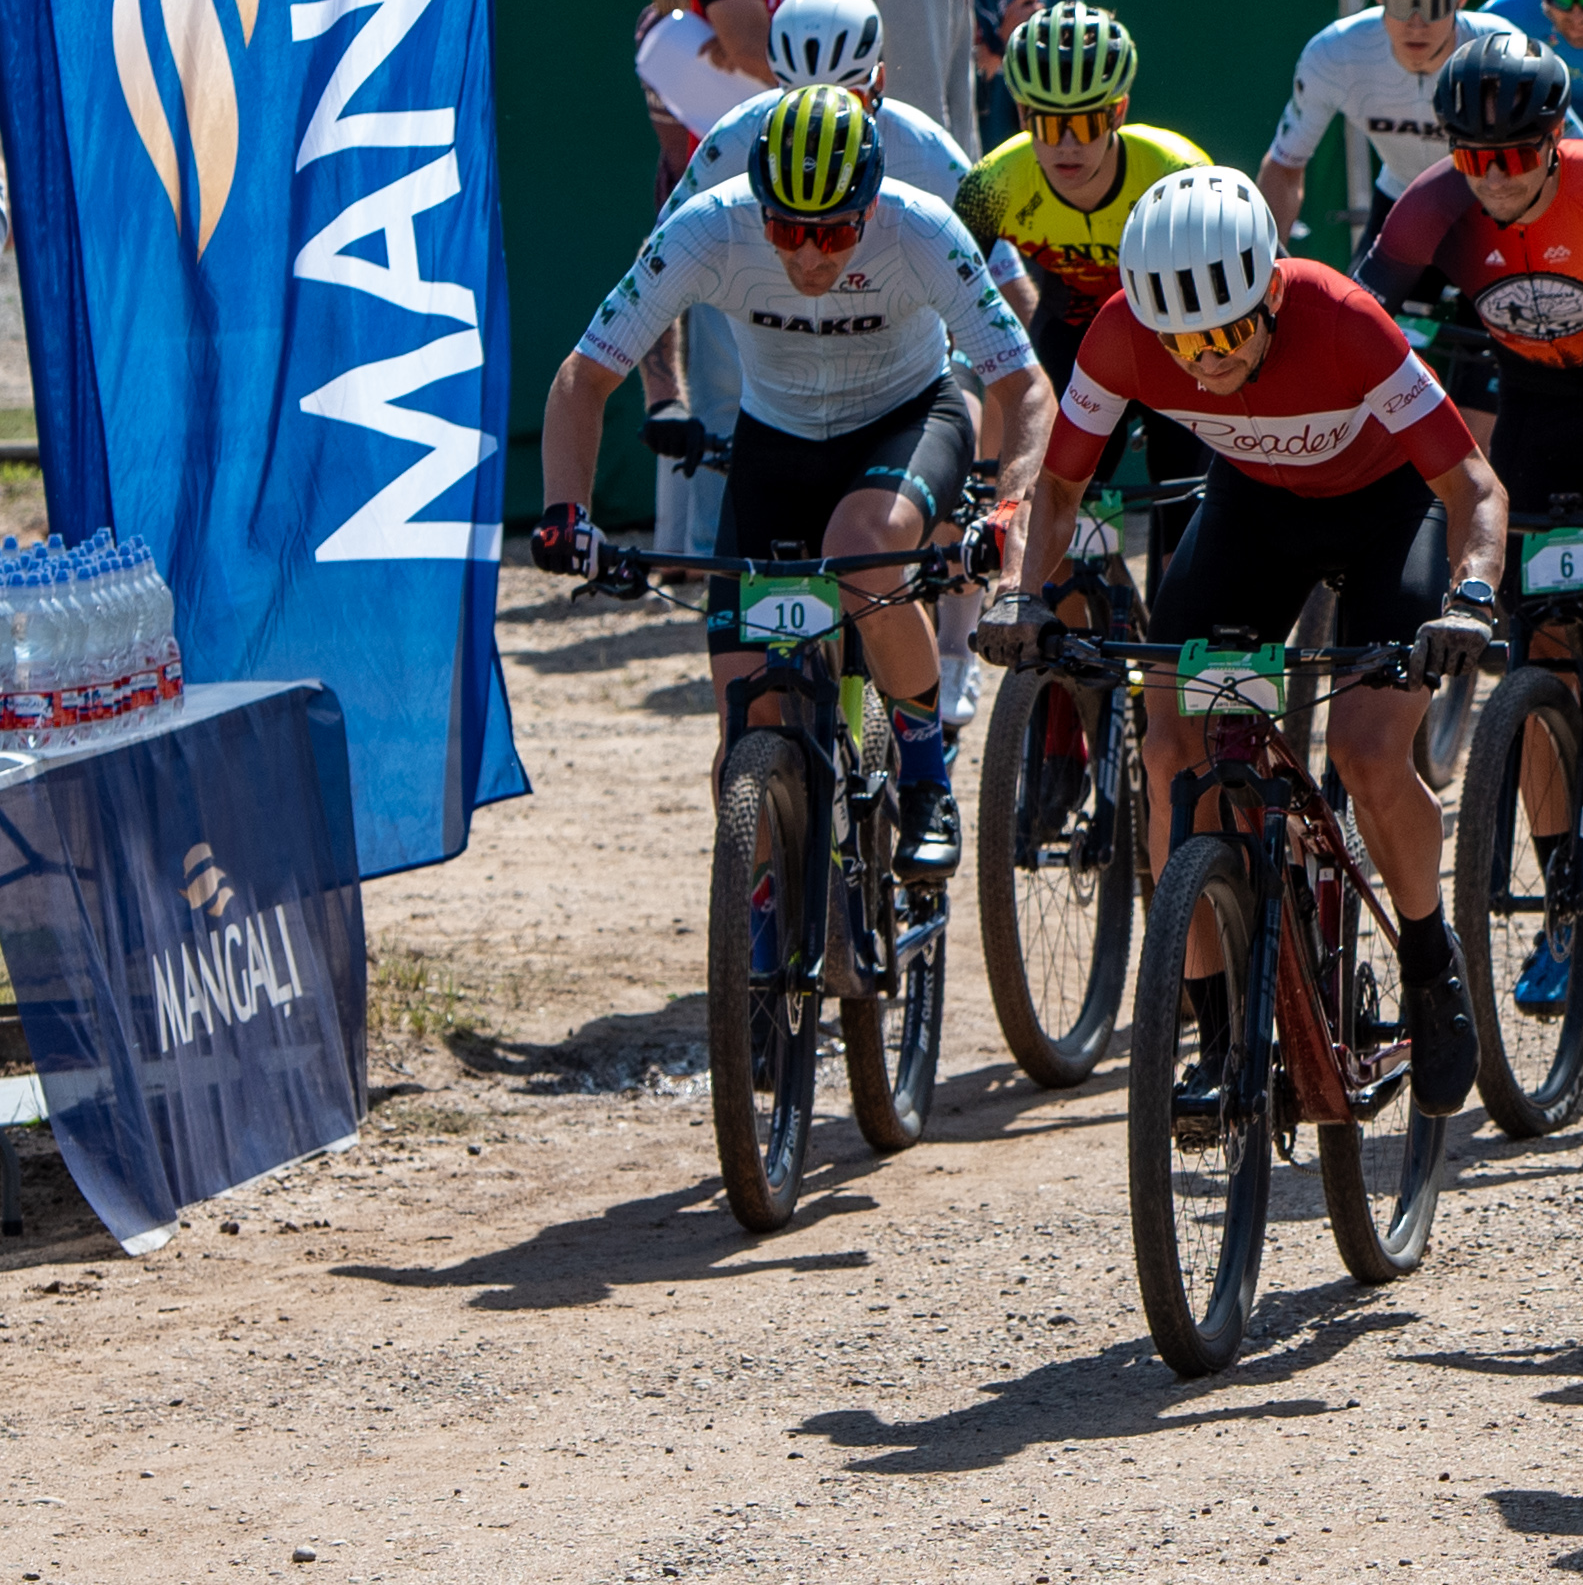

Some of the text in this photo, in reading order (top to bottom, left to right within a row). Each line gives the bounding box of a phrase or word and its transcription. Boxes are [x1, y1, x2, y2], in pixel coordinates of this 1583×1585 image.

[1366, 116, 1450, 142] DAK
[750, 310, 886, 336] DAKO
[1175, 416, 1353, 459] Roadex
[1561, 551, 1574, 578] 6
[774, 602, 806, 630] 10
[152, 904, 303, 1054] MANGAĻI
